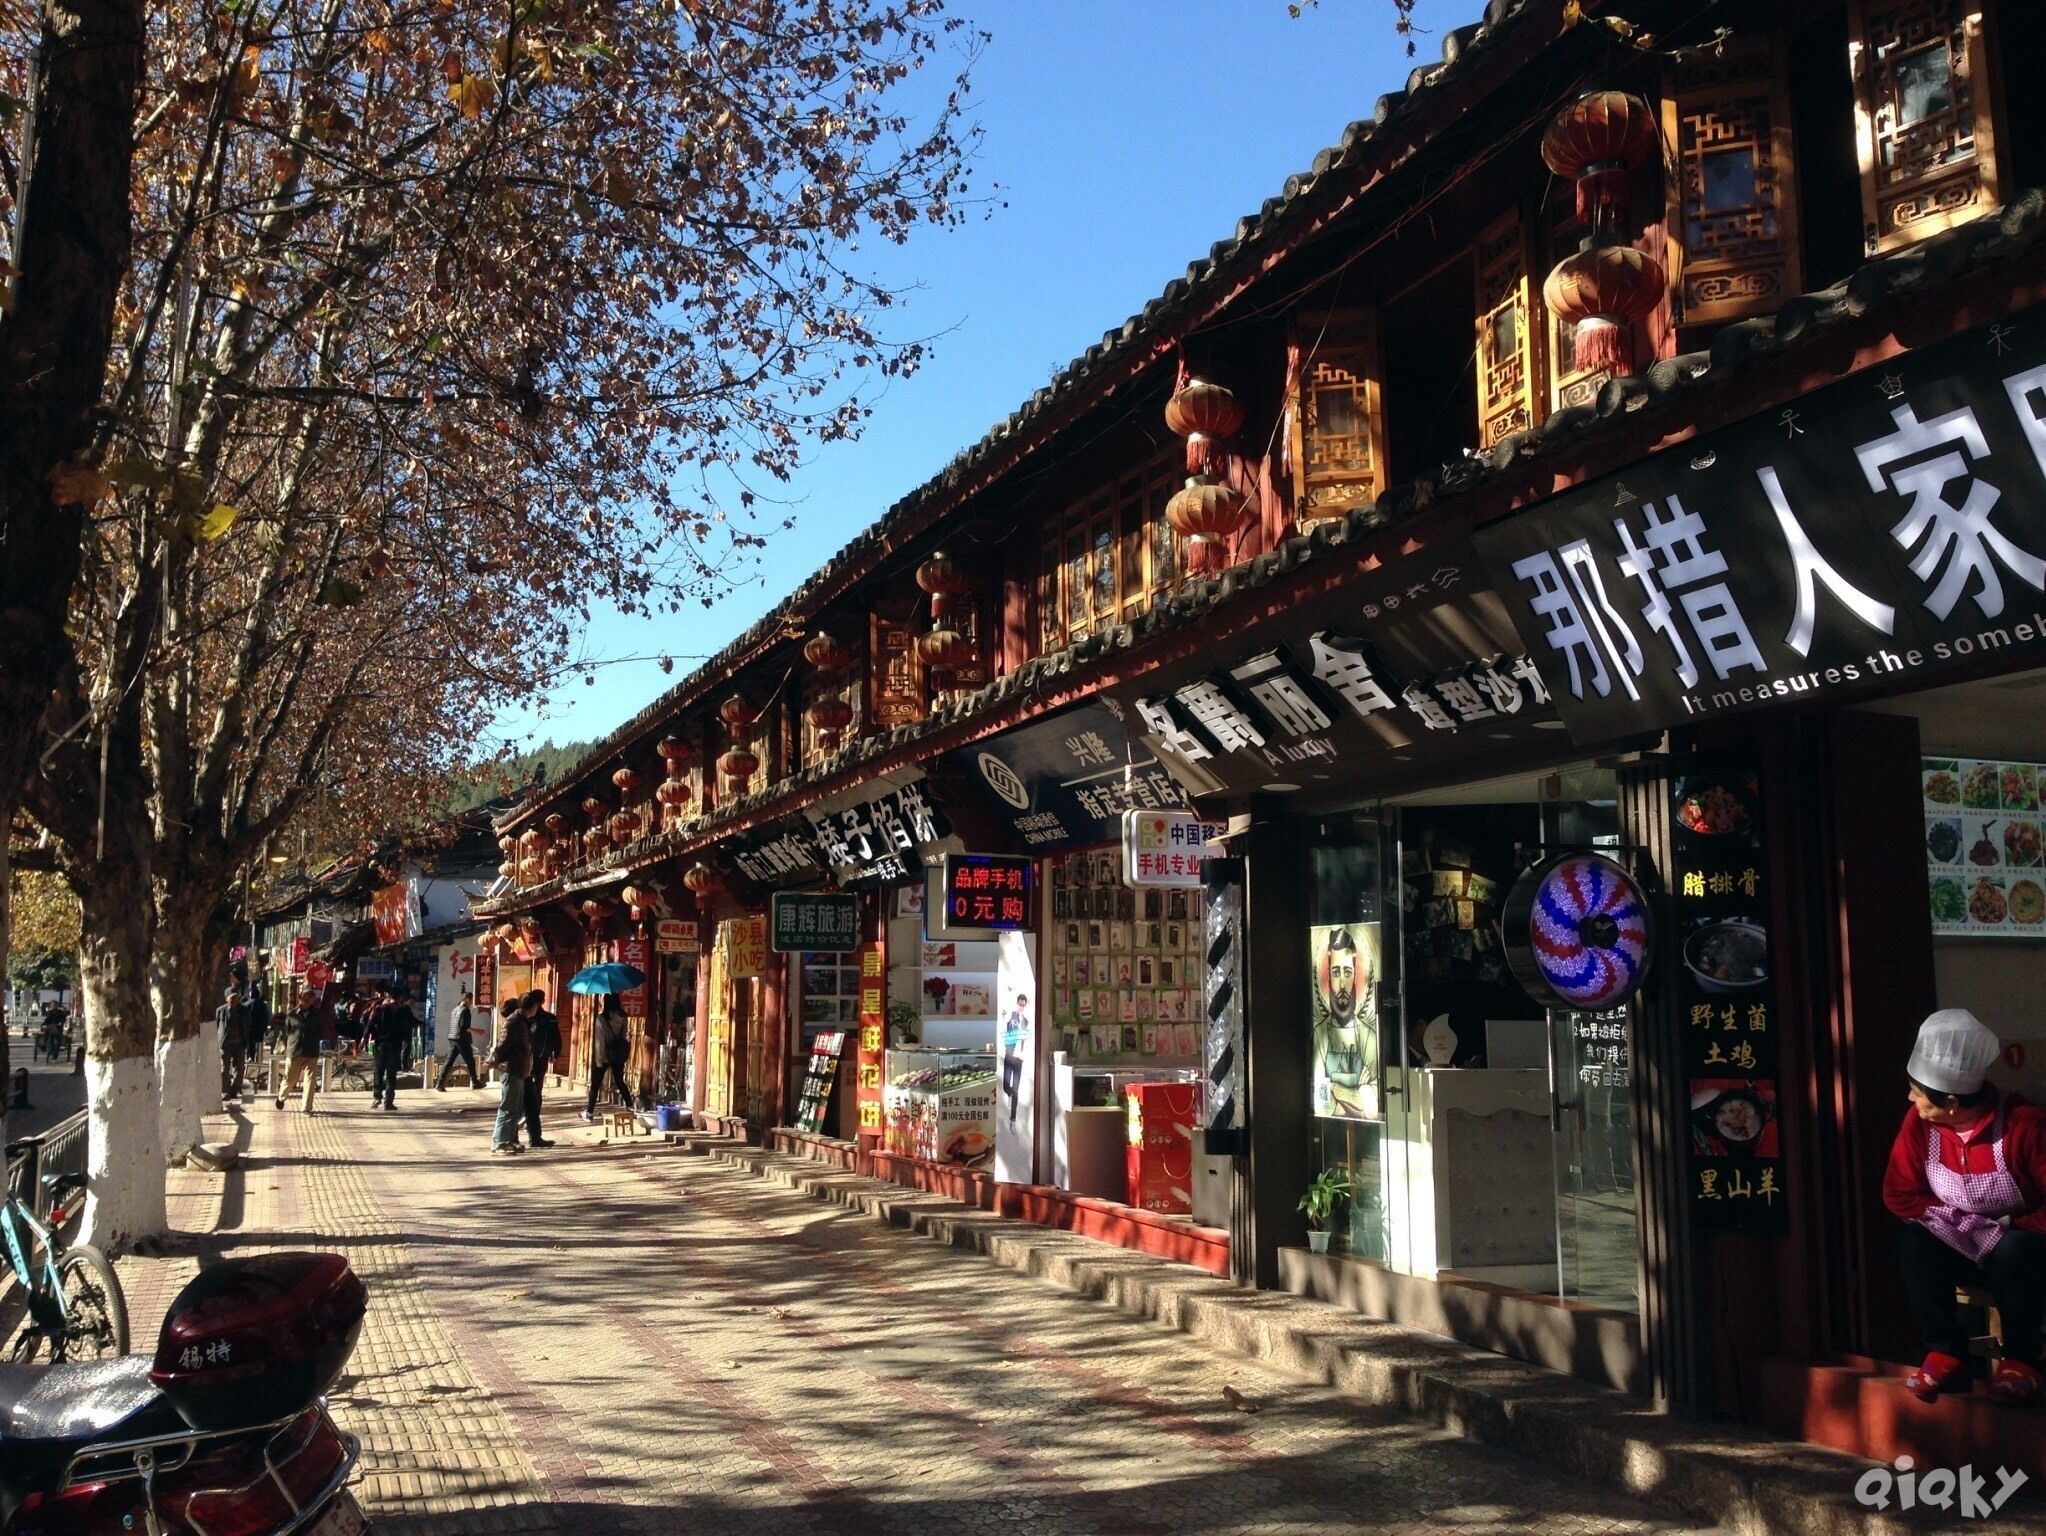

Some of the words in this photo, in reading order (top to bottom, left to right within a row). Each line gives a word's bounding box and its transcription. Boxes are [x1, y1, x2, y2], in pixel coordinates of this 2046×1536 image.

[1682, 694, 1707, 716] It
[1714, 662, 1861, 707] measures
[1866, 649, 1926, 676] the
[1064, 731, 1116, 767] 兴隆
[955, 867, 1023, 890] 品牌手机
[1139, 853, 1225, 876] 手机专业
[1683, 867, 1760, 897] 腊排骨
[779, 903, 854, 933] 康辉旅游
[955, 896, 1023, 921] 0元购
[733, 923, 764, 947] 沙县
[733, 951, 764, 973] 小吃
[1691, 1003, 1768, 1032] 野生菌
[1704, 1040, 1757, 1068] 土鸡
[1698, 1167, 1780, 1206] 黑山羊
